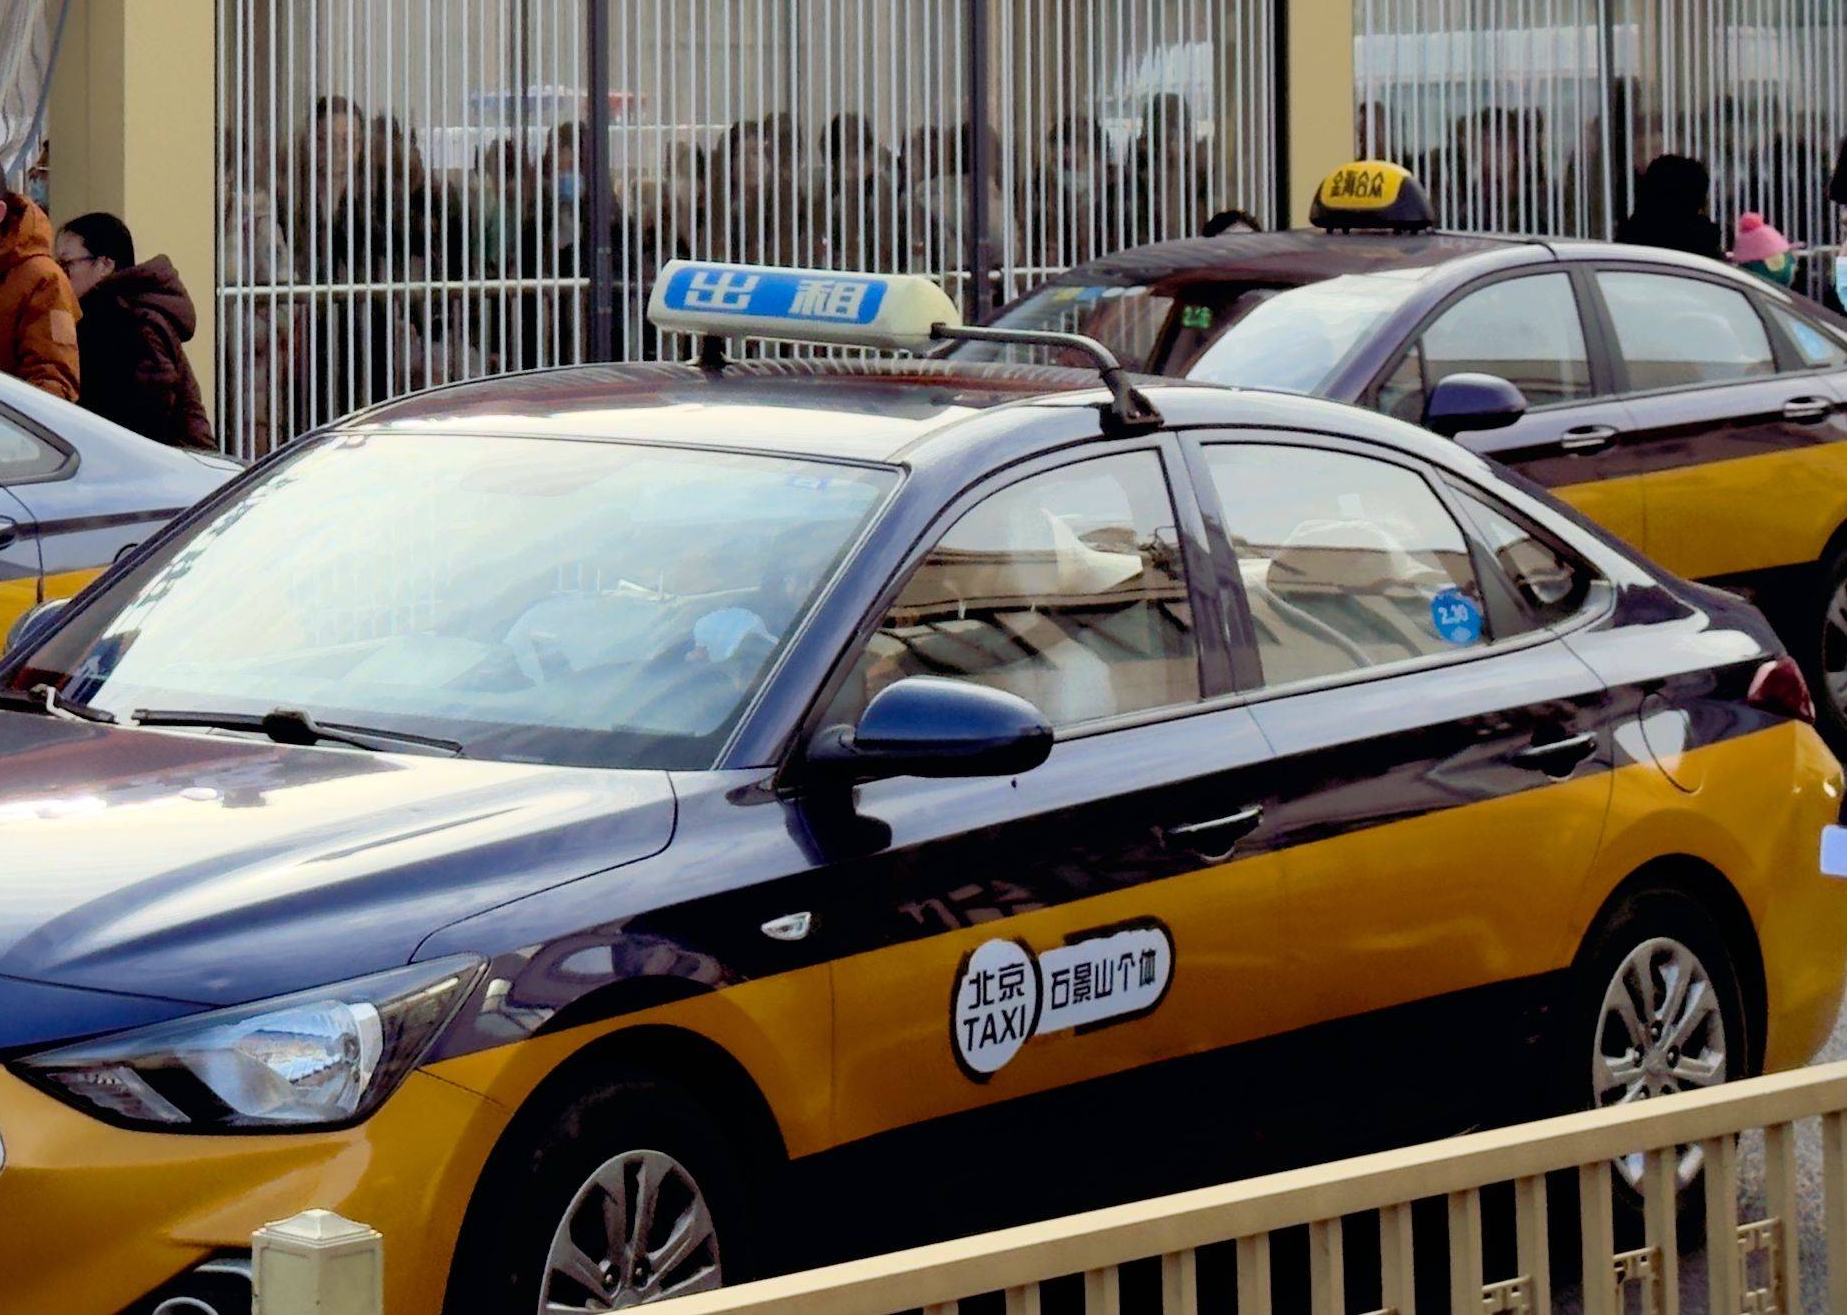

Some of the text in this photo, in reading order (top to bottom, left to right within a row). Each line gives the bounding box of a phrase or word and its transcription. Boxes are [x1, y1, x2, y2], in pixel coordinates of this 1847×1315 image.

[683, 270, 869, 319] 出租
[968, 963, 1026, 1010] 北京
[963, 1003, 1026, 1052] TAXI
